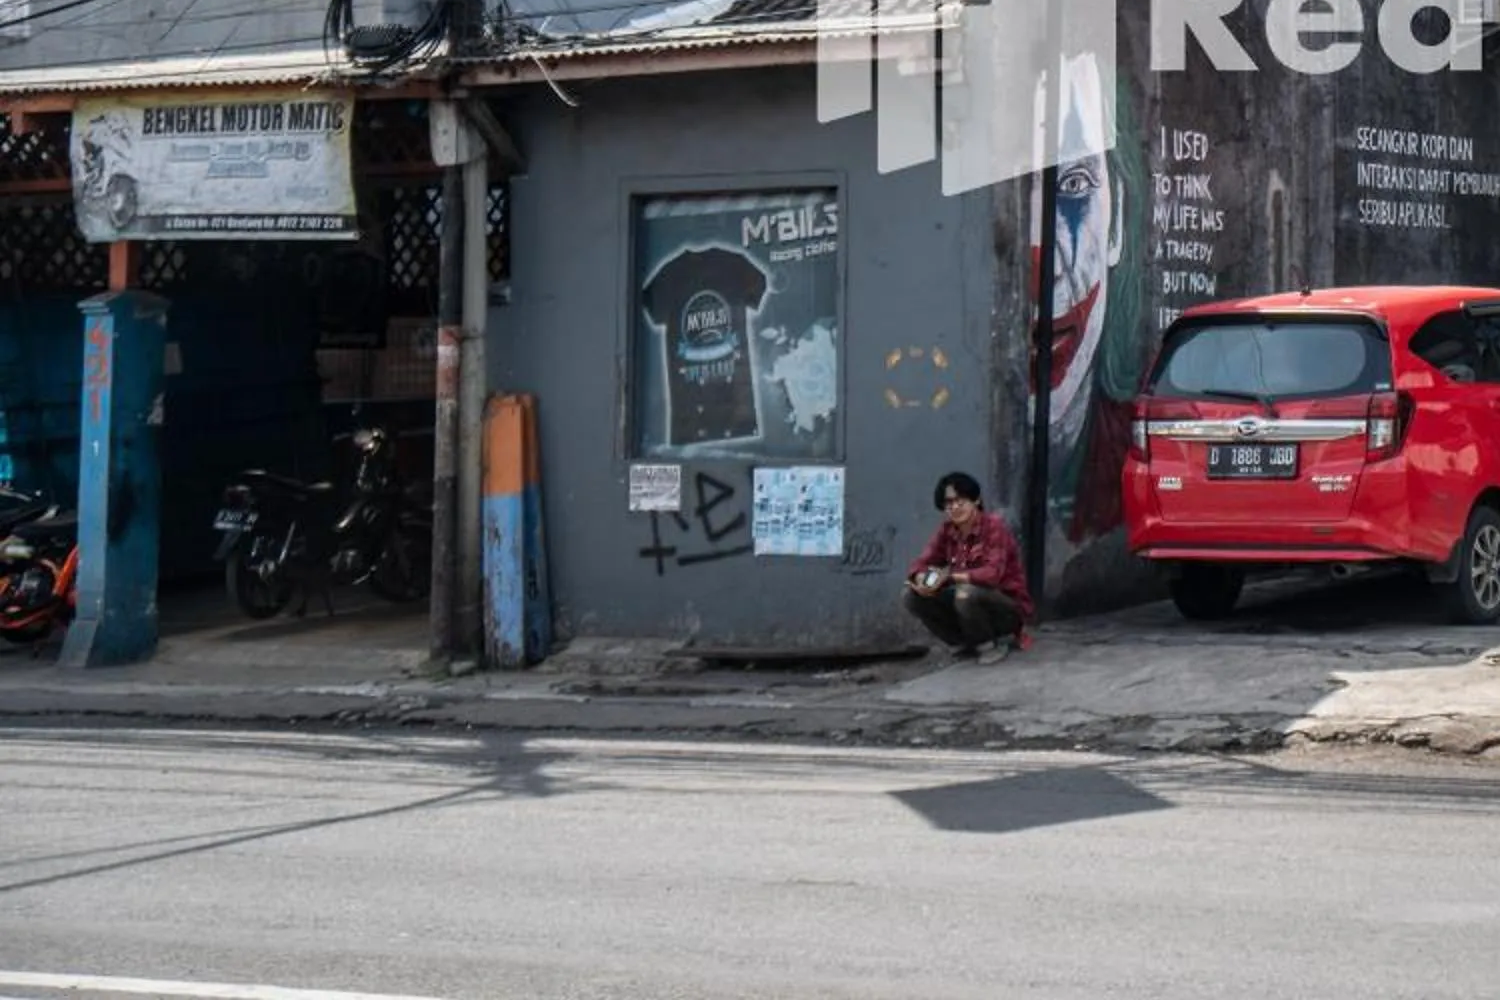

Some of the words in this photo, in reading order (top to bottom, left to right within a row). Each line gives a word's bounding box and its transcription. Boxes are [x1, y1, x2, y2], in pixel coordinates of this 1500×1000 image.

[142, 105, 217, 135] BENGKEL
[221, 104, 283, 133] MOTOR
[287, 102, 345, 131] MATIC
[1160, 125, 1166, 158] I
[1173, 128, 1209, 161] USED
[1356, 127, 1418, 156] SECANGKIR
[1421, 133, 1447, 159] KOPI
[1450, 136, 1473, 161] DAN
[1153, 172, 1171, 196] TO
[1174, 172, 1213, 201] THINK
[1357, 160, 1417, 190] INTERAKSI
[1418, 167, 1451, 193] DAPAT
[1153, 204, 1173, 233] MY
[1173, 202, 1199, 231] LIFE
[1201, 210, 1225, 232] WAS
[1359, 198, 1397, 225] SERIBU
[1155, 240, 1163, 259] A
[1165, 239, 1214, 264] TRAGEDY
[1162, 270, 1187, 294] BUT
[1189, 270, 1217, 297] NOW
[1158, 306, 1163, 329] I
[1210, 446, 1219, 465] D
